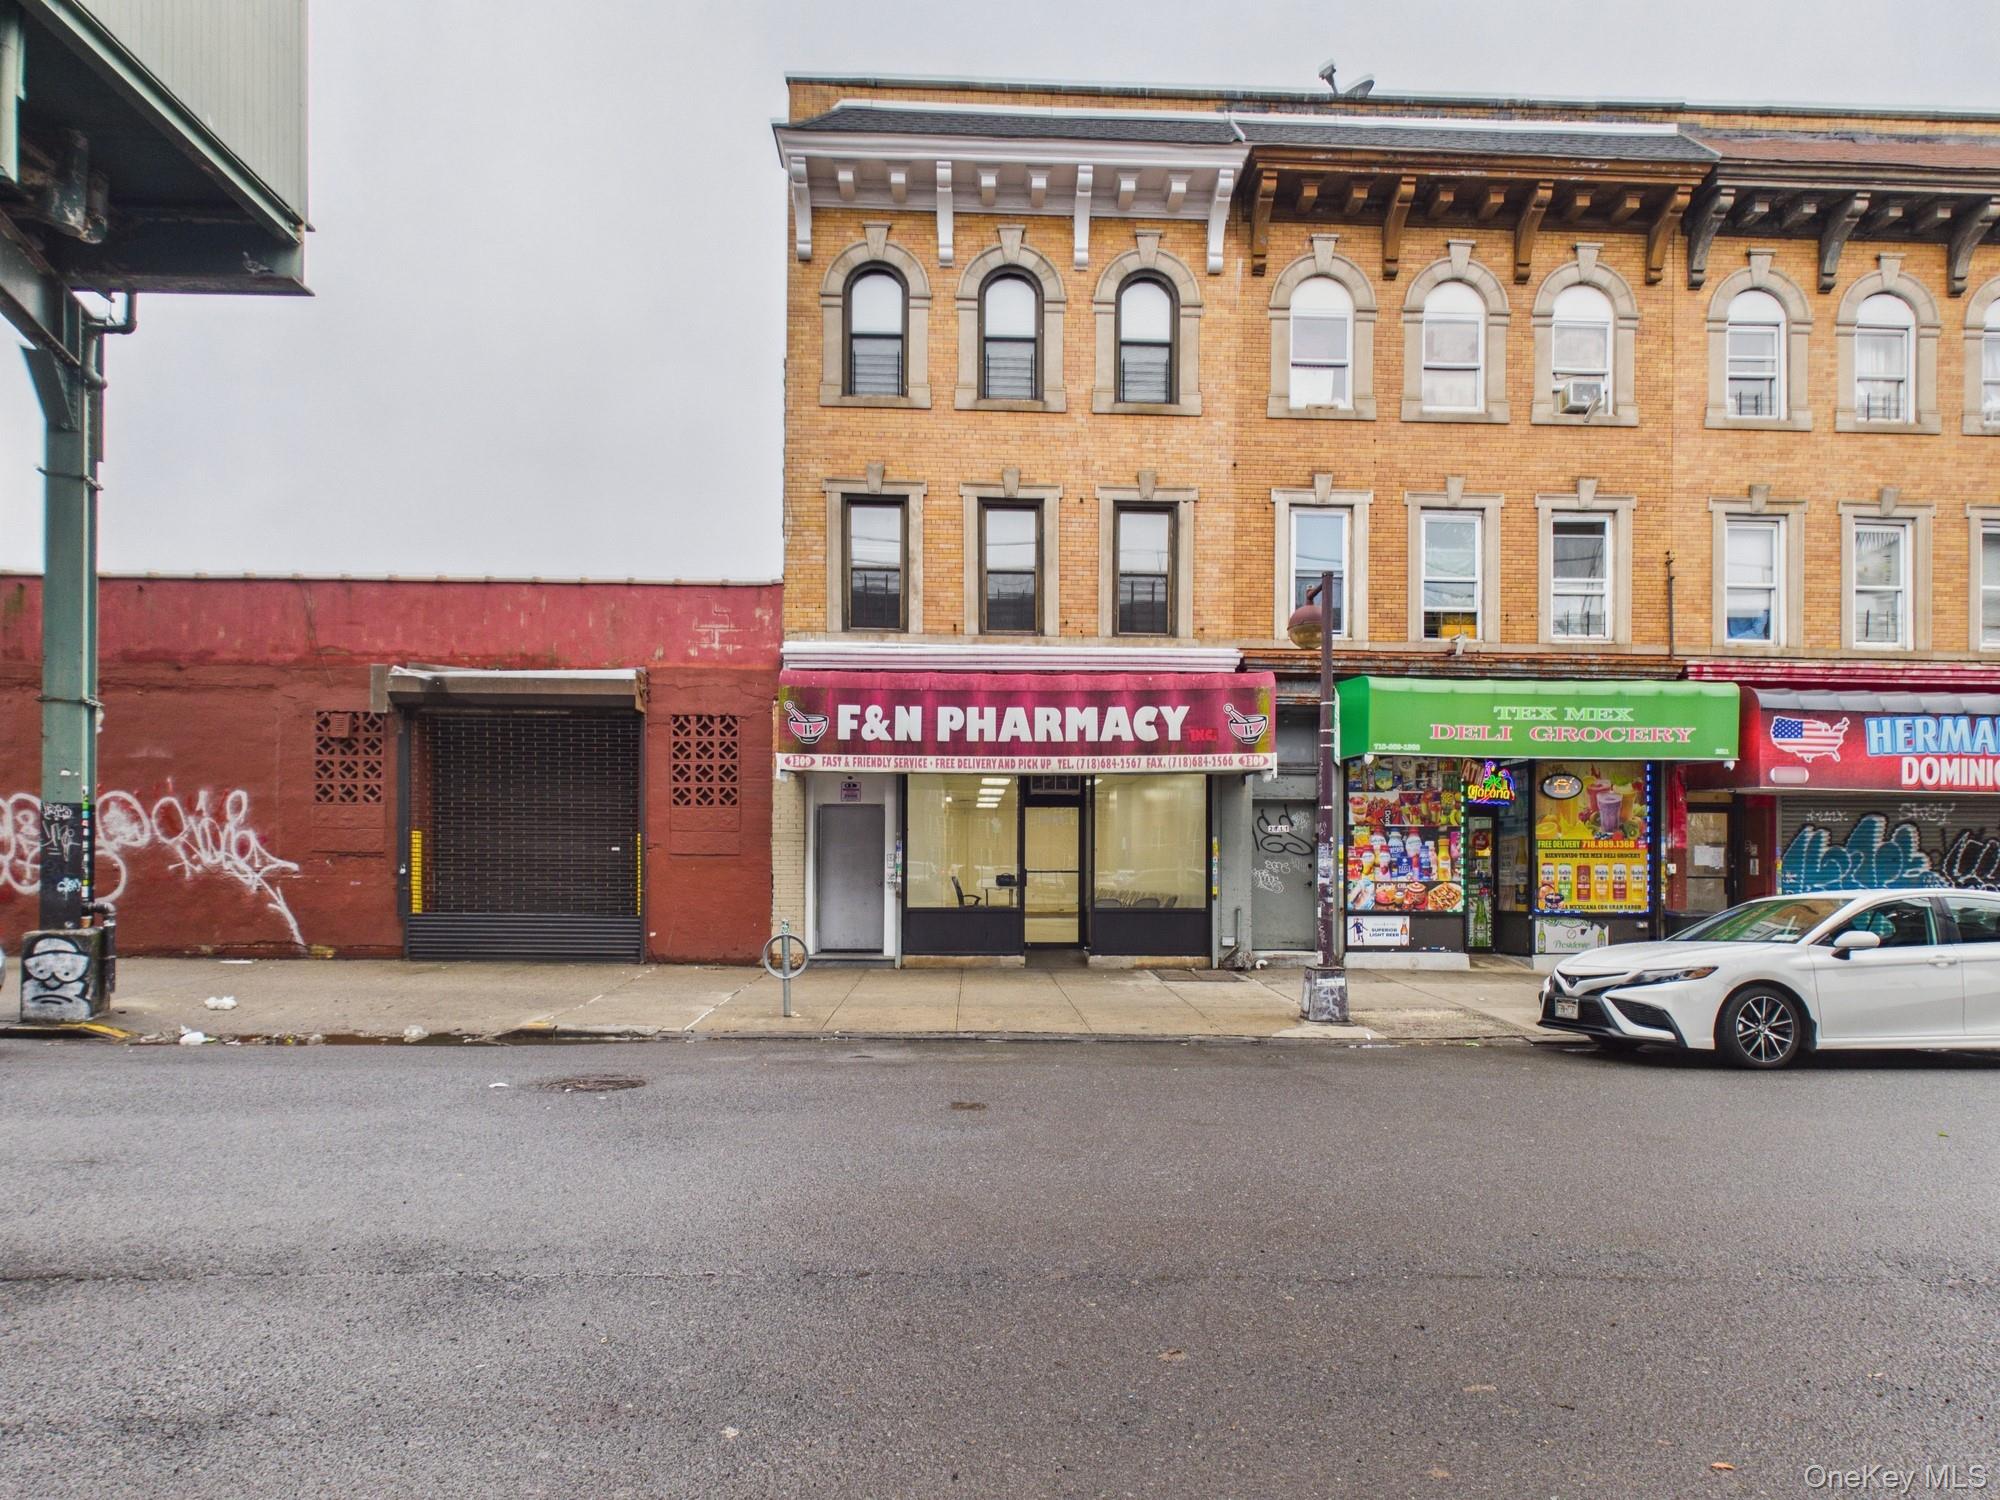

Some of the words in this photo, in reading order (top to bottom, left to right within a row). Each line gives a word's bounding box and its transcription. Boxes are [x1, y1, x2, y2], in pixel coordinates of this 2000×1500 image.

[1493, 706, 1557, 721] TEX
[1564, 707, 1634, 722] MEX
[837, 704, 923, 742] F&N
[937, 705, 1190, 742] PHARMACY
[1430, 724, 1513, 742] DELI
[1529, 726, 1697, 743] GROCERY
[1865, 716, 2000, 756] HERMA
[821, 756, 842, 768] FAST
[844, 757, 851, 768] &
[852, 757, 892, 769] FRIENDLY
[894, 758, 928, 769] SERVICE
[935, 758, 956, 769] FREE
[957, 758, 997, 769] DELIVERY
[999, 758, 1016, 770] AND
[1018, 758, 1038, 770] PICK
[1040, 758, 1051, 770] UP
[1057, 758, 1074, 770] TEL.
[1146, 758, 1166, 769] FAX.
[1461, 760, 1485, 785] ATM
[1468, 784, 1511, 800] Corona
[1537, 840, 1552, 848] FREE
[1552, 840, 1580, 849] DELIVERY
